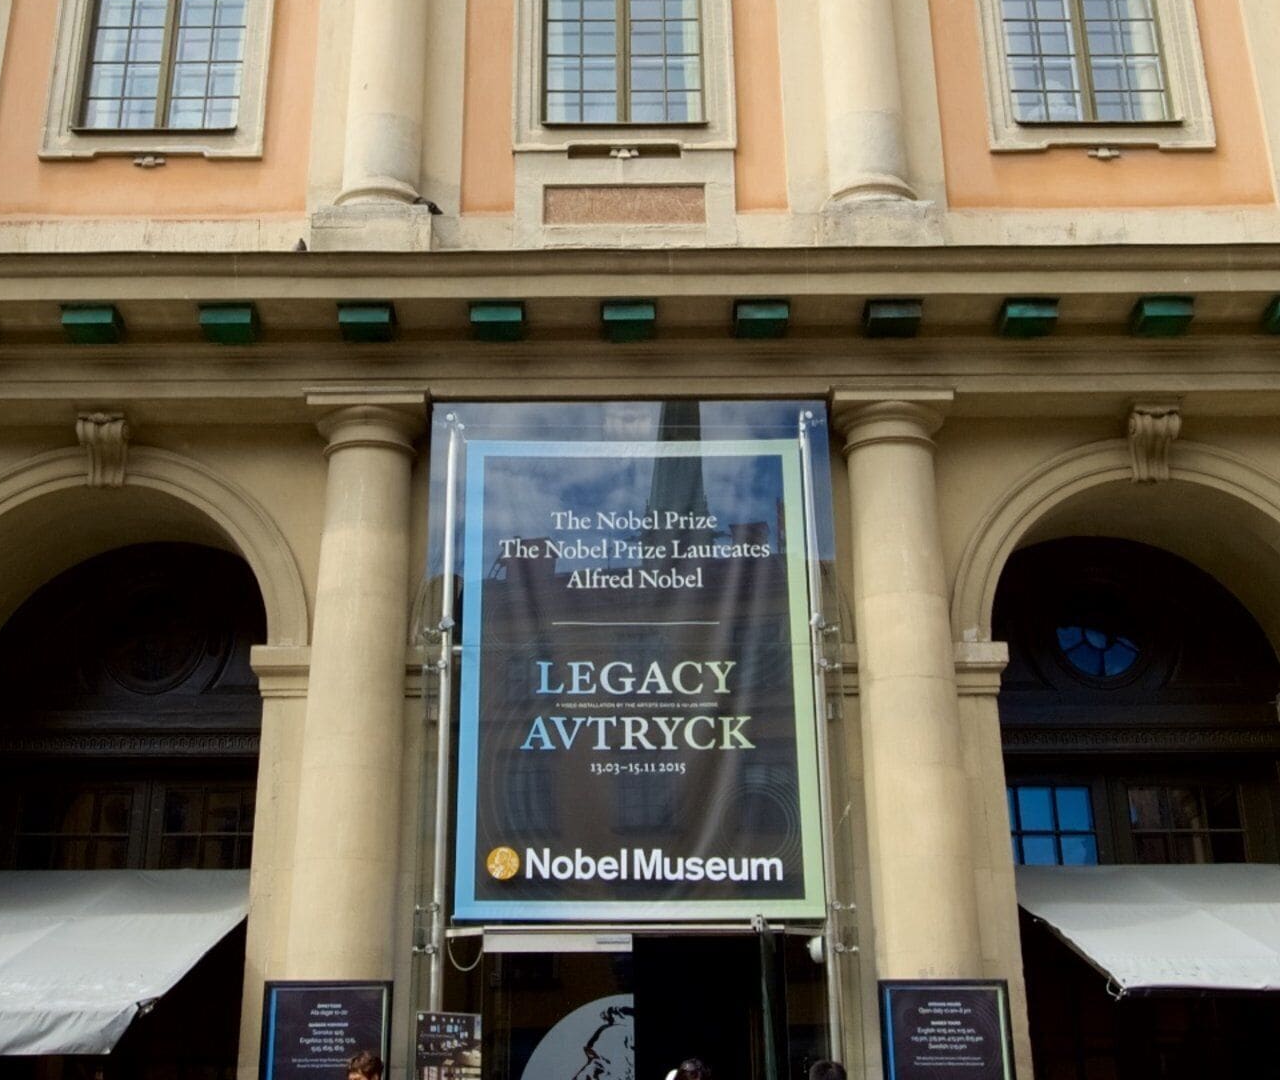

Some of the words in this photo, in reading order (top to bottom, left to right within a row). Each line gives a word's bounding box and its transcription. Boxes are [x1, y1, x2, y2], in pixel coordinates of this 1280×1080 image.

[550, 510, 592, 530] The
[596, 510, 659, 530] Nobel
[664, 510, 718, 530] Prize
[498, 538, 540, 560] The
[545, 538, 608, 560] Nobel
[612, 538, 667, 560] Prize
[671, 538, 771, 560] Laureates
[566, 567, 634, 589] Alfred
[638, 567, 704, 589] Nobel
[535, 660, 737, 695] LEGACY
[520, 715, 757, 751] AVTRYCK
[659, 762, 686, 775] 2015
